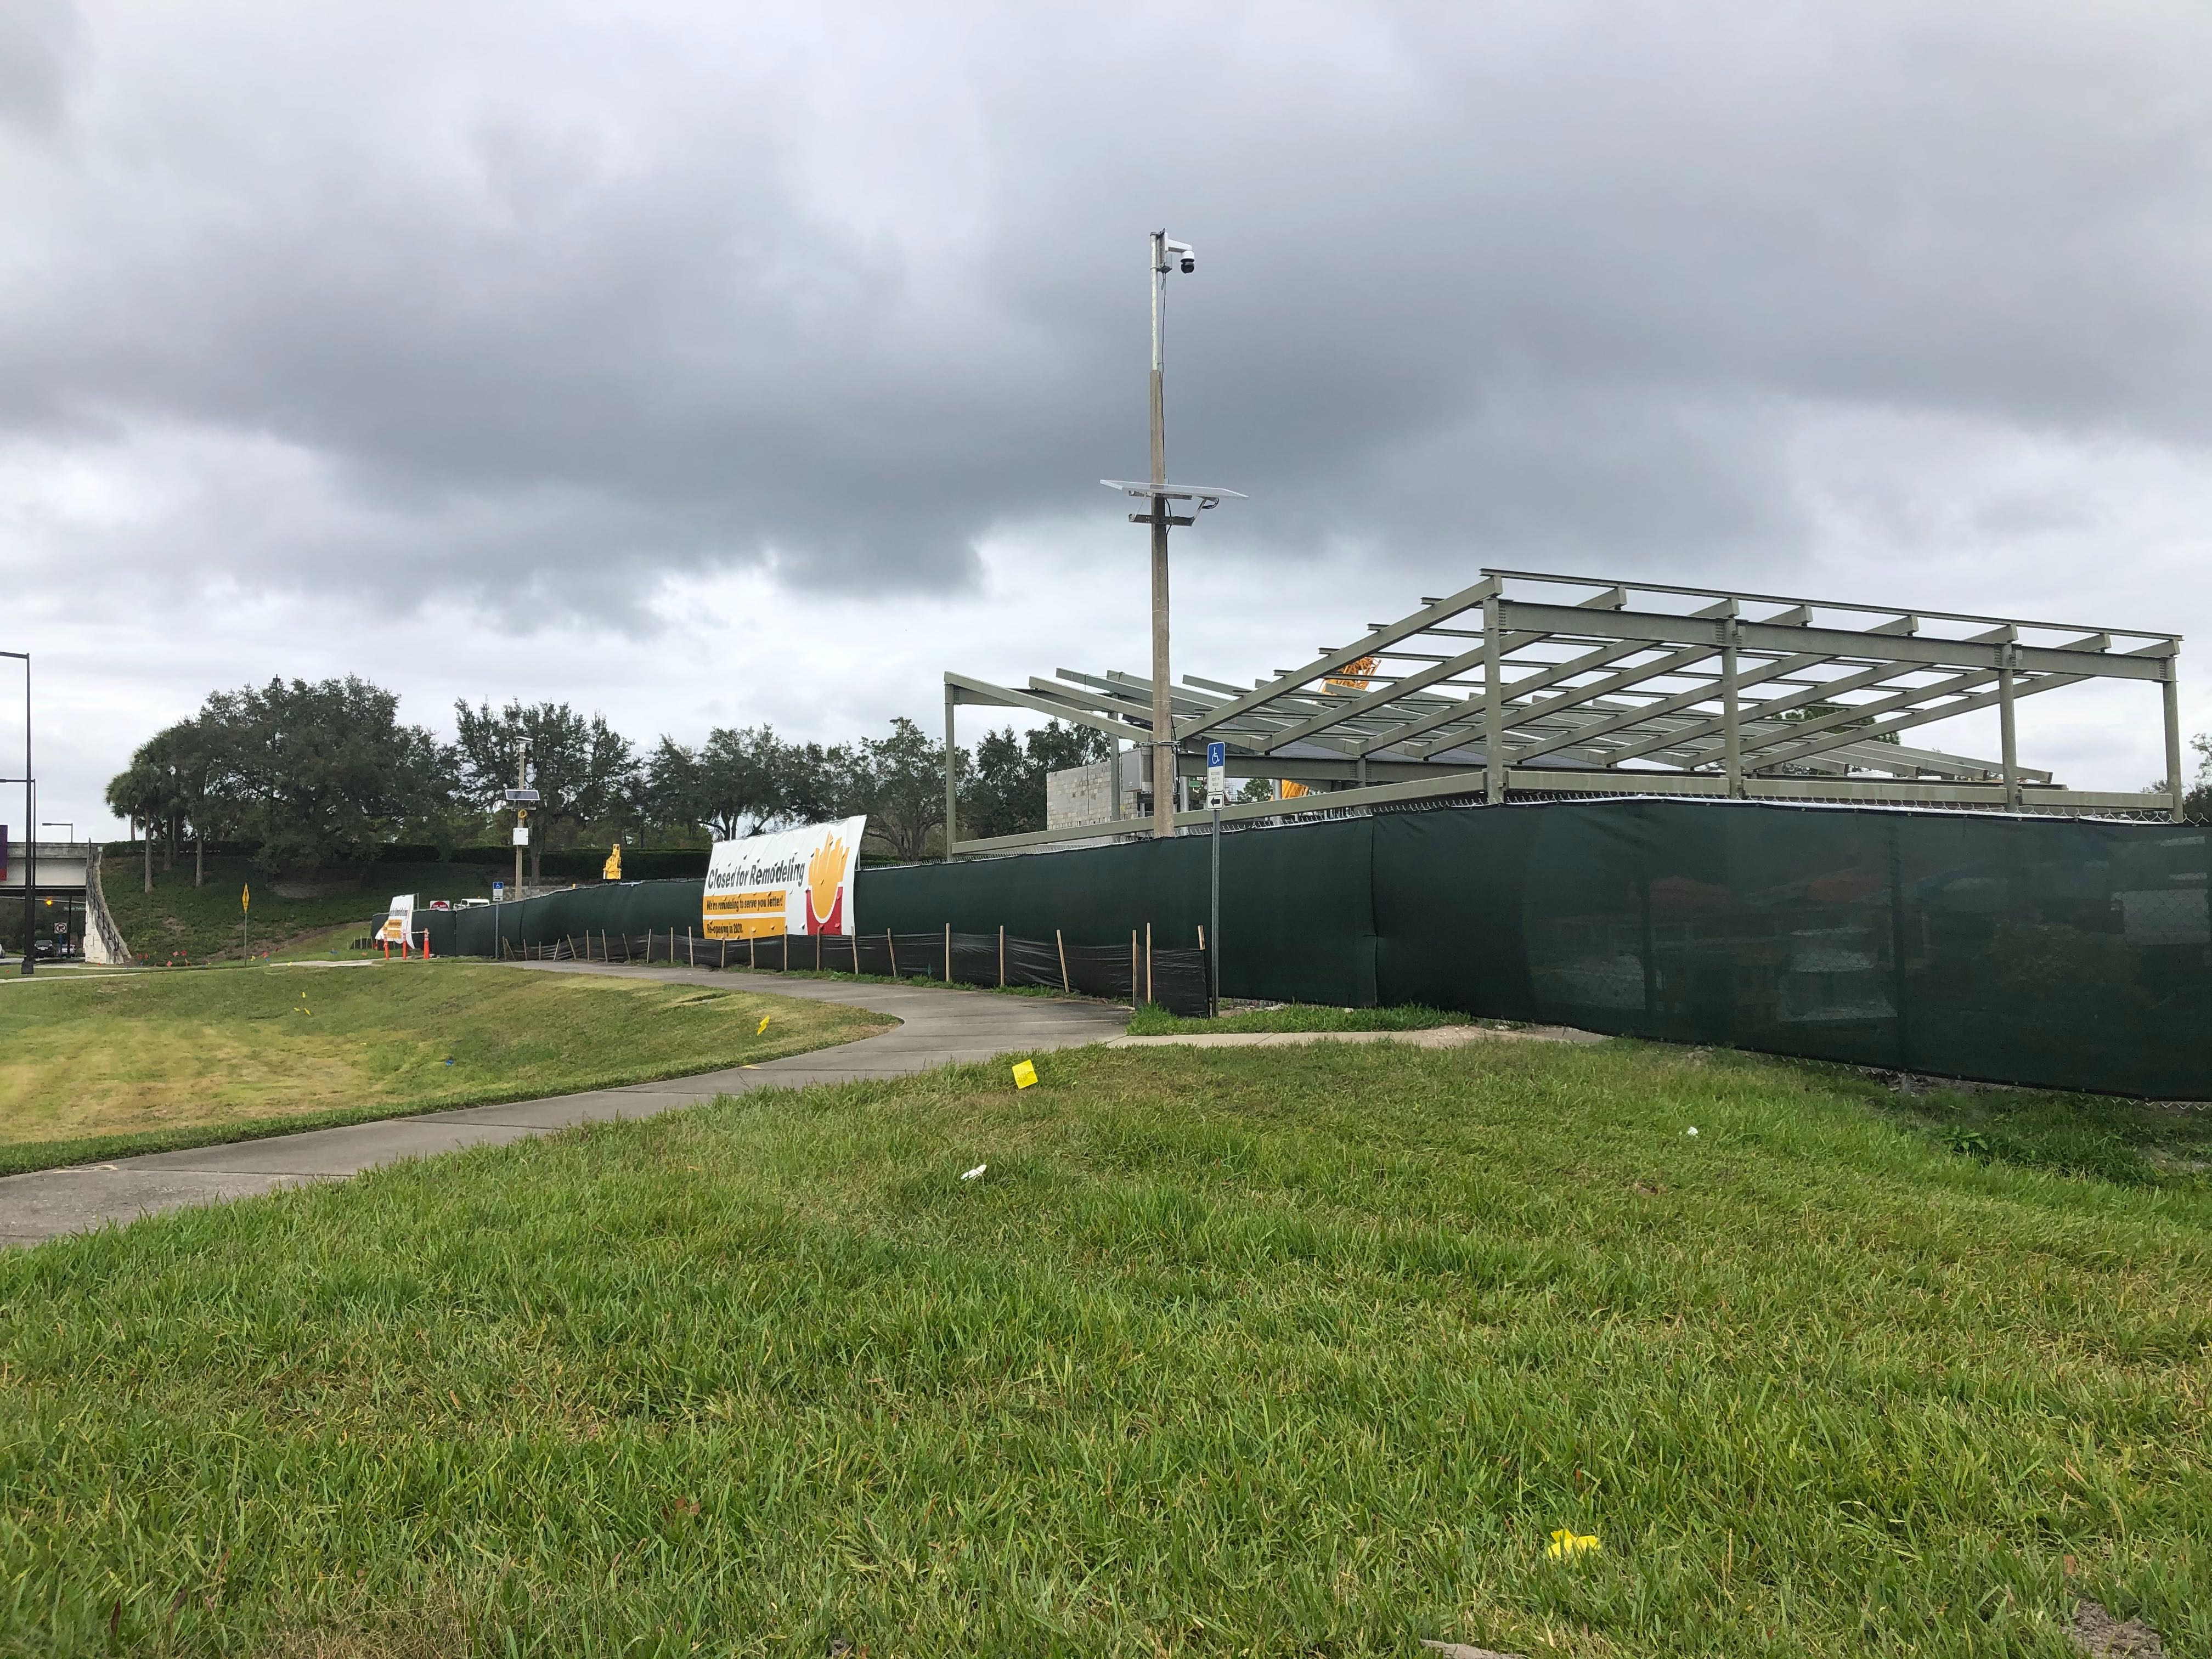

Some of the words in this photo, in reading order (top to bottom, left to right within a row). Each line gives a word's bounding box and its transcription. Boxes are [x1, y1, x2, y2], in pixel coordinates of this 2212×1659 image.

[708, 866, 738, 889] Closed
[736, 865, 749, 887] for
[749, 857, 805, 887] Remodeling
[718, 899, 739, 912] remodeling
[744, 900, 757, 909] serve
[758, 899, 766, 911] you
[767, 895, 783, 907] better!
[729, 923, 733, 934] in
